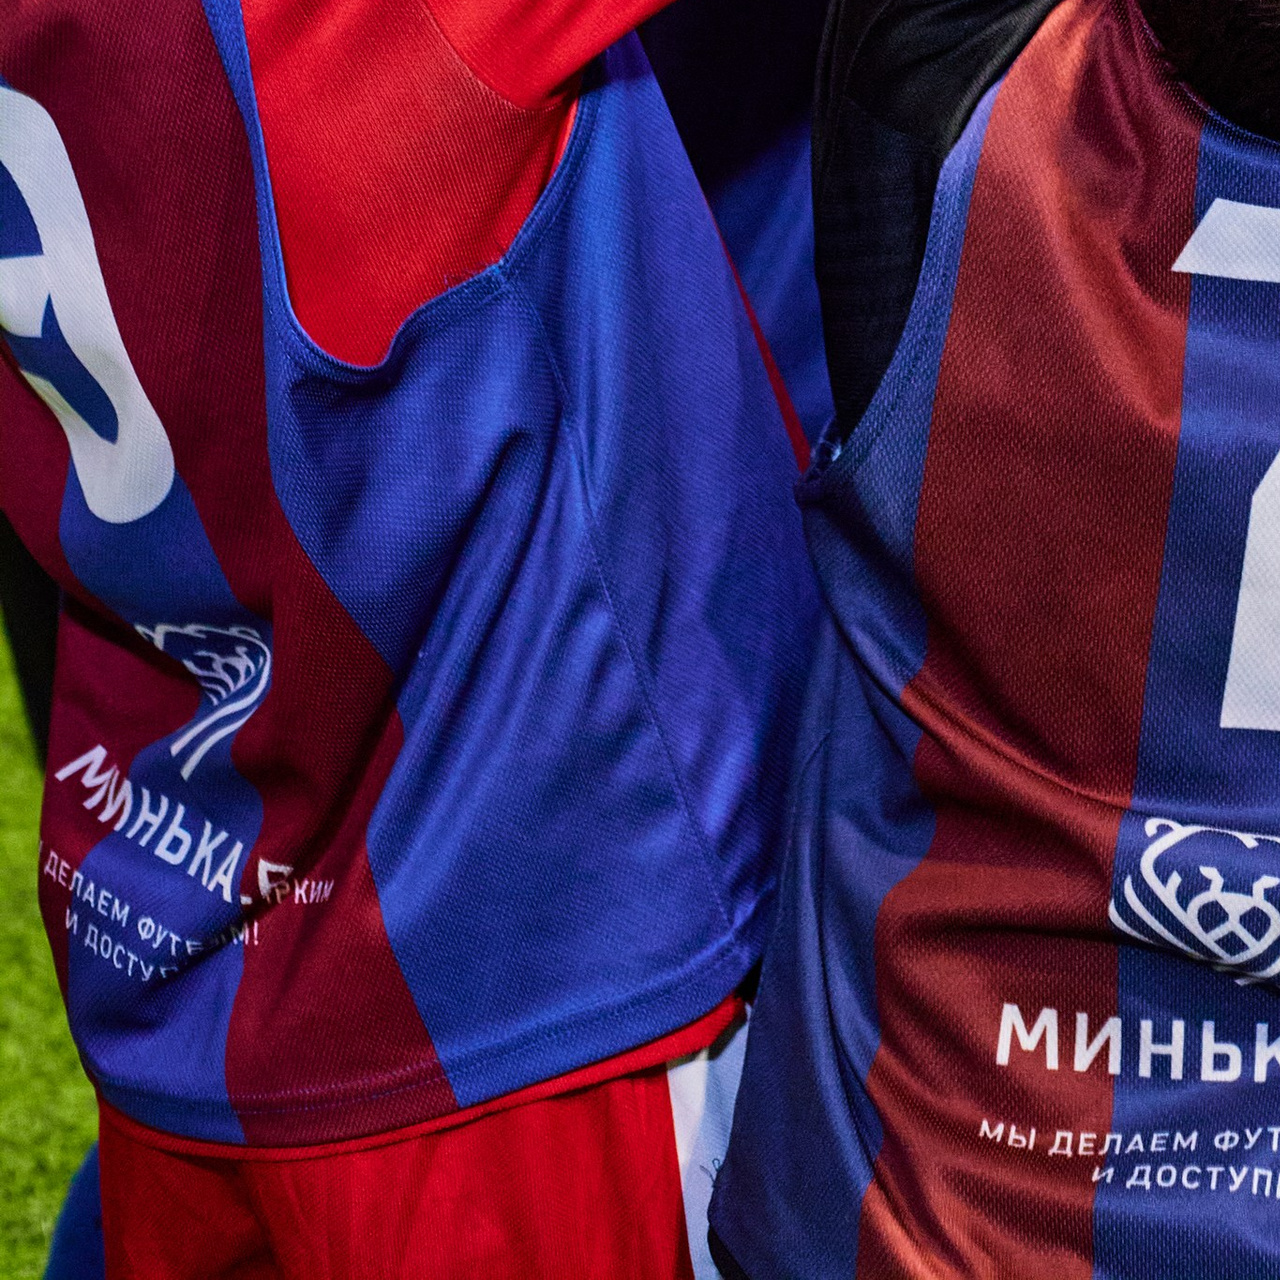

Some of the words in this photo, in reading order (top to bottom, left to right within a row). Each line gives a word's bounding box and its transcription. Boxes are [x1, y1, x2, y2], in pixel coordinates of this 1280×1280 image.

[44, 851, 131, 927] ДЕЛАЕМ
[65, 908, 79, 935] И
[978, 1118, 1036, 1151] МЫ
[1047, 1130, 1199, 1158] ДЕЛАЕМ
[1091, 1167, 1115, 1185] И
